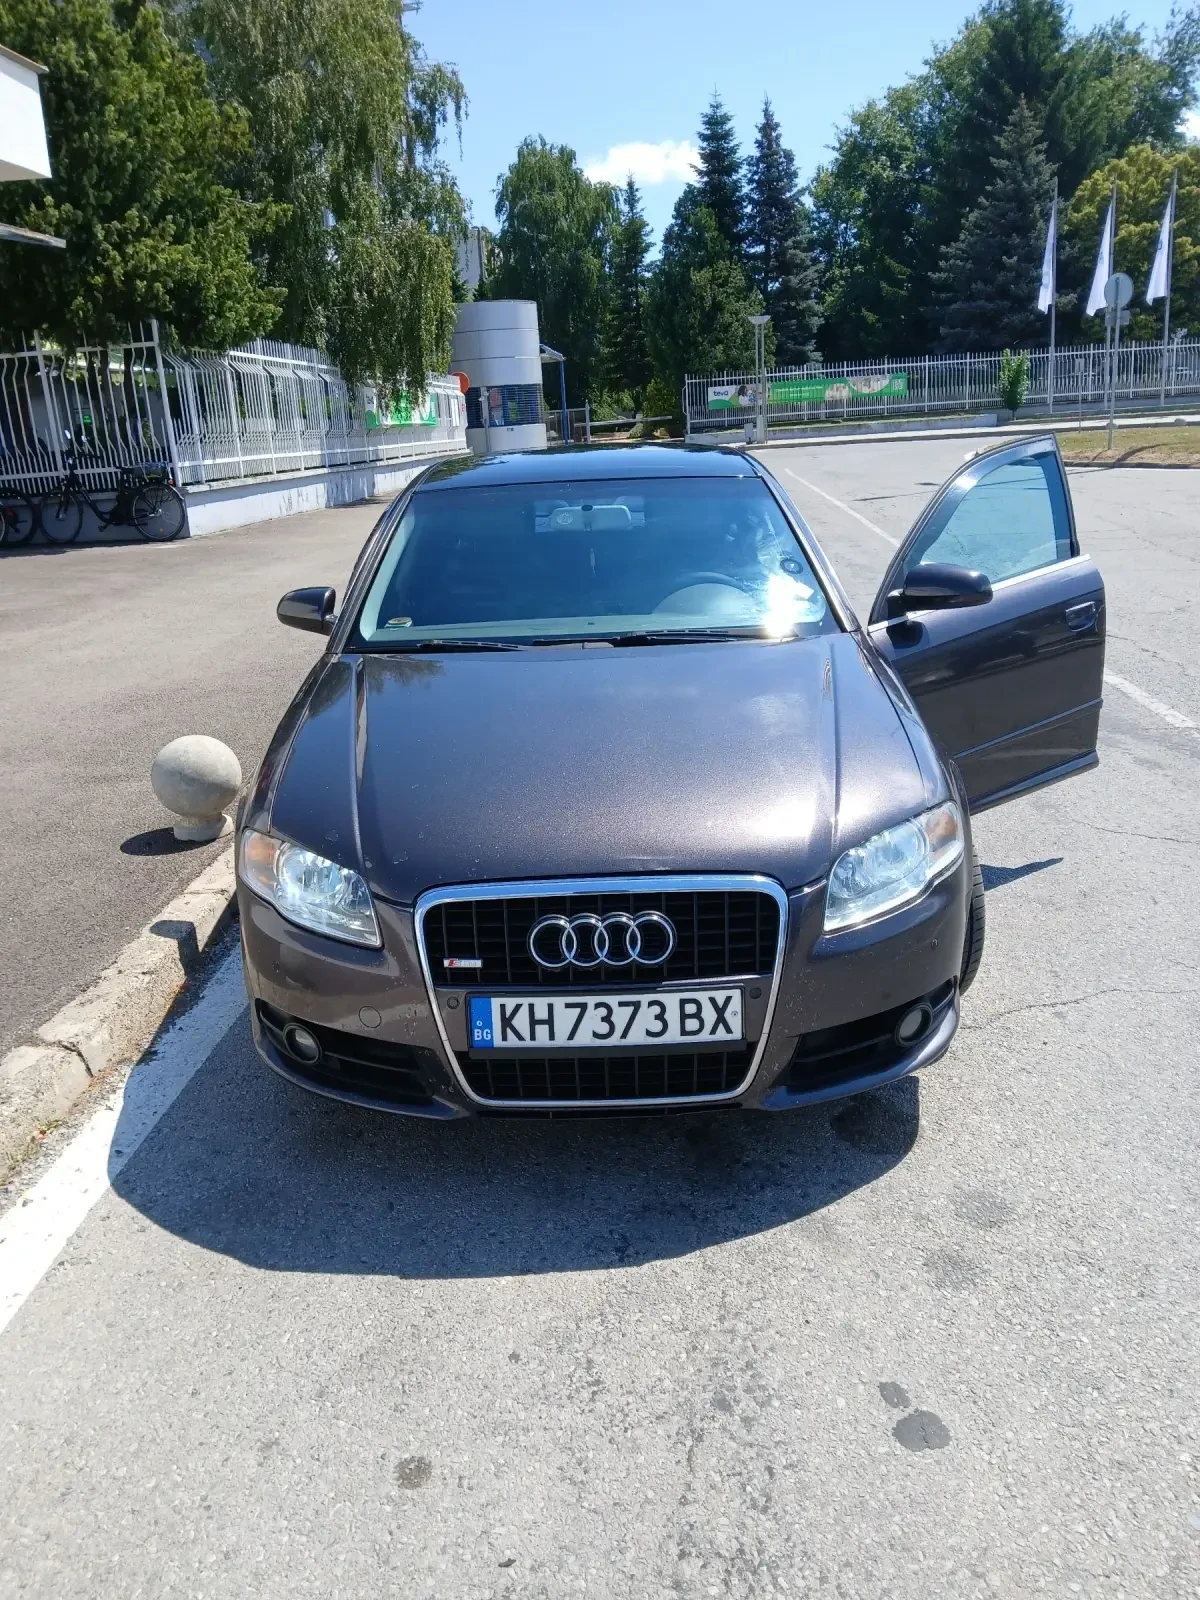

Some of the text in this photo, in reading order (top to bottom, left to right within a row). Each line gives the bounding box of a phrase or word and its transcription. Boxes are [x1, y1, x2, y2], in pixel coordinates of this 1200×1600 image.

[499, 995, 734, 1042] KH 7373 BX
[474, 1028, 491, 1040] BG
